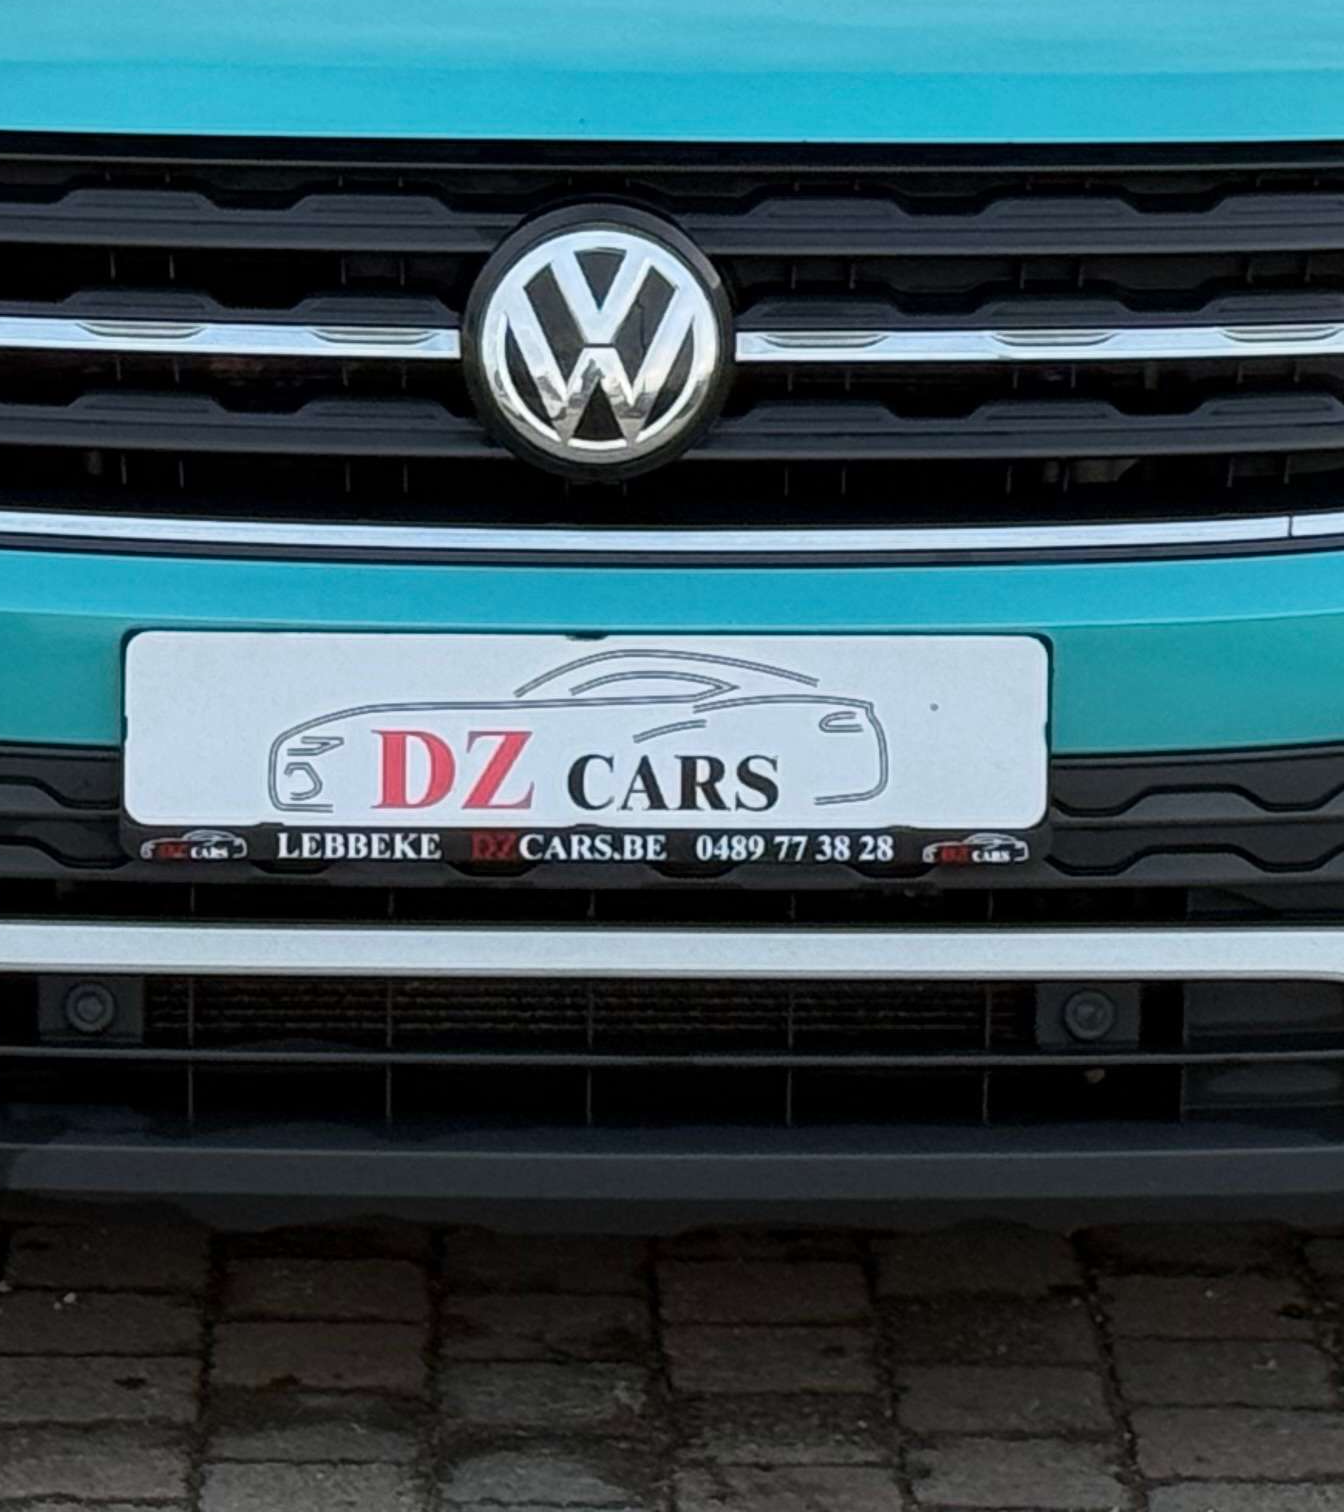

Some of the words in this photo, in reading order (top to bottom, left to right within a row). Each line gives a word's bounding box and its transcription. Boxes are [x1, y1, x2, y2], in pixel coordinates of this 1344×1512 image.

[482, 230, 718, 464] VW
[370, 729, 534, 811] DZ
[565, 753, 780, 813] CARS
[277, 832, 443, 859] LEBBEKE
[695, 834, 765, 861] 0489
[773, 835, 808, 861] 77
[814, 834, 851, 861] 38
[858, 834, 895, 861] 28
